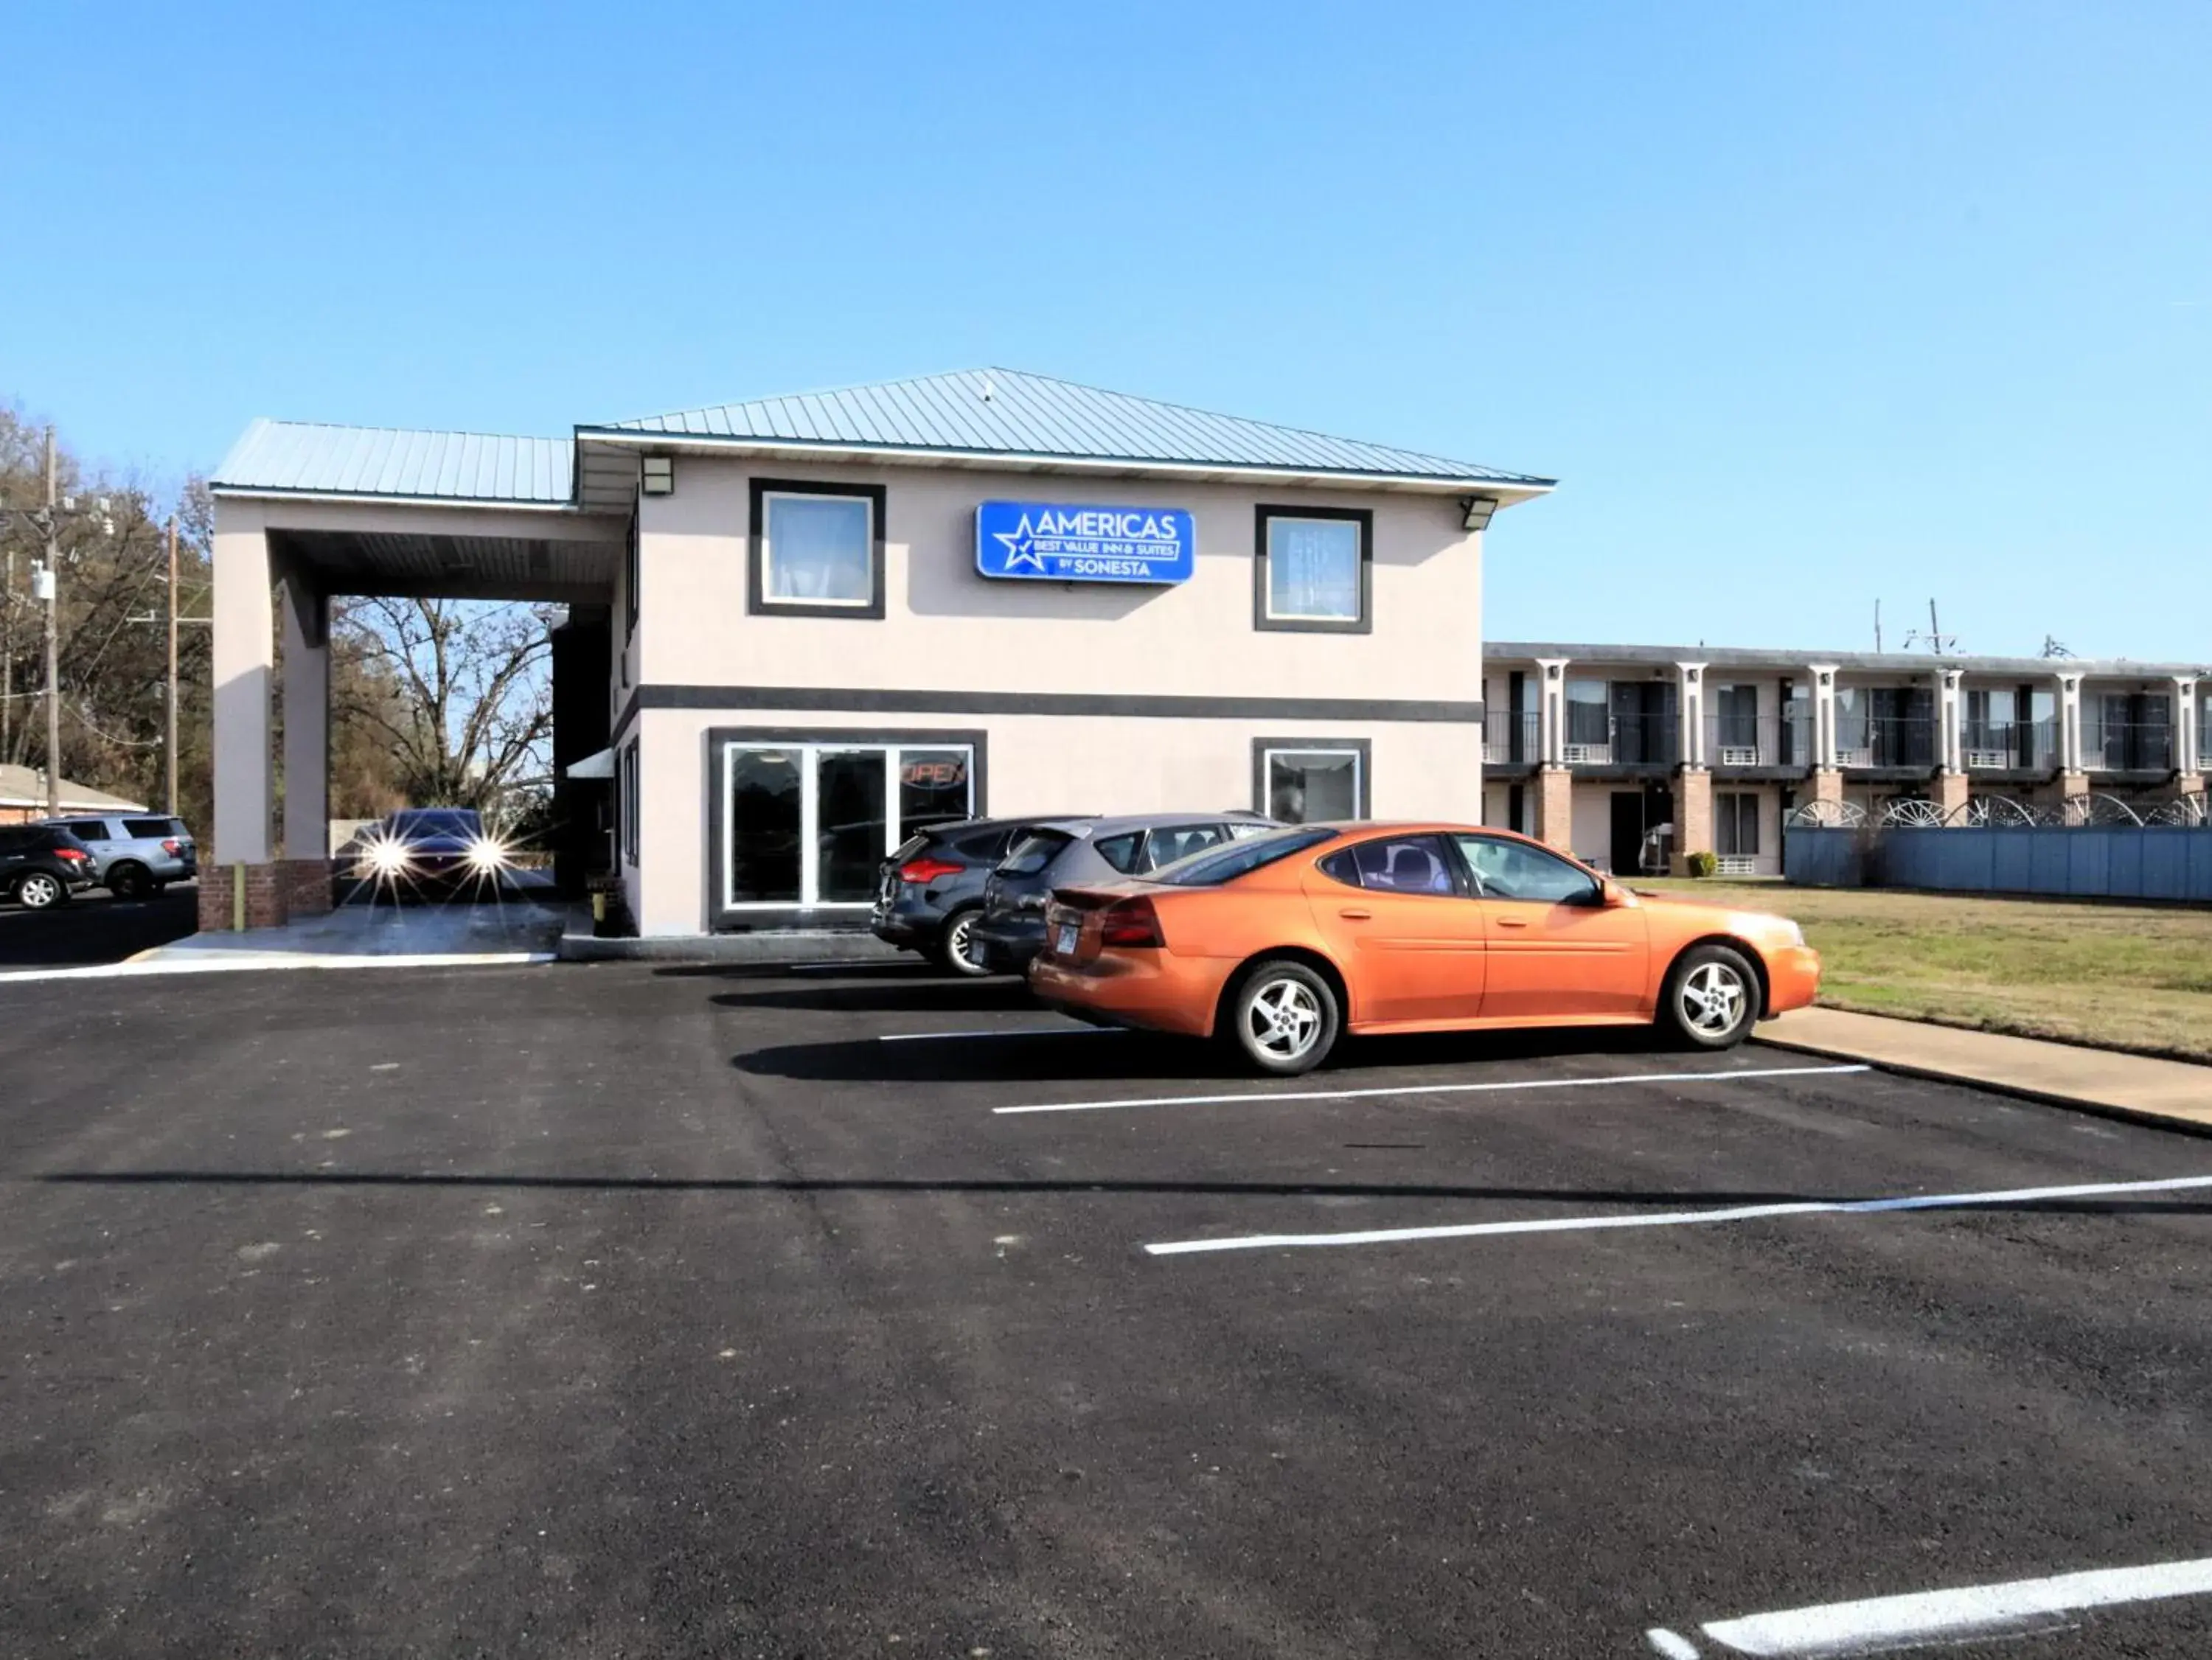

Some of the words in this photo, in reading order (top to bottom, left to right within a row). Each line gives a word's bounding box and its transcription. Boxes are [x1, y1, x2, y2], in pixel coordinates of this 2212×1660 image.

[1036, 510, 1177, 539] AMERICAS
[1034, 540, 1061, 552] BEST
[1063, 541, 1098, 553] VALUE
[1102, 542, 1123, 554] INN
[1124, 543, 1134, 554] &
[1136, 545, 1174, 556] SUITES
[1060, 559, 1072, 568] BY
[1074, 559, 1150, 575] SONESTA
[900, 764, 966, 782] OPEN
